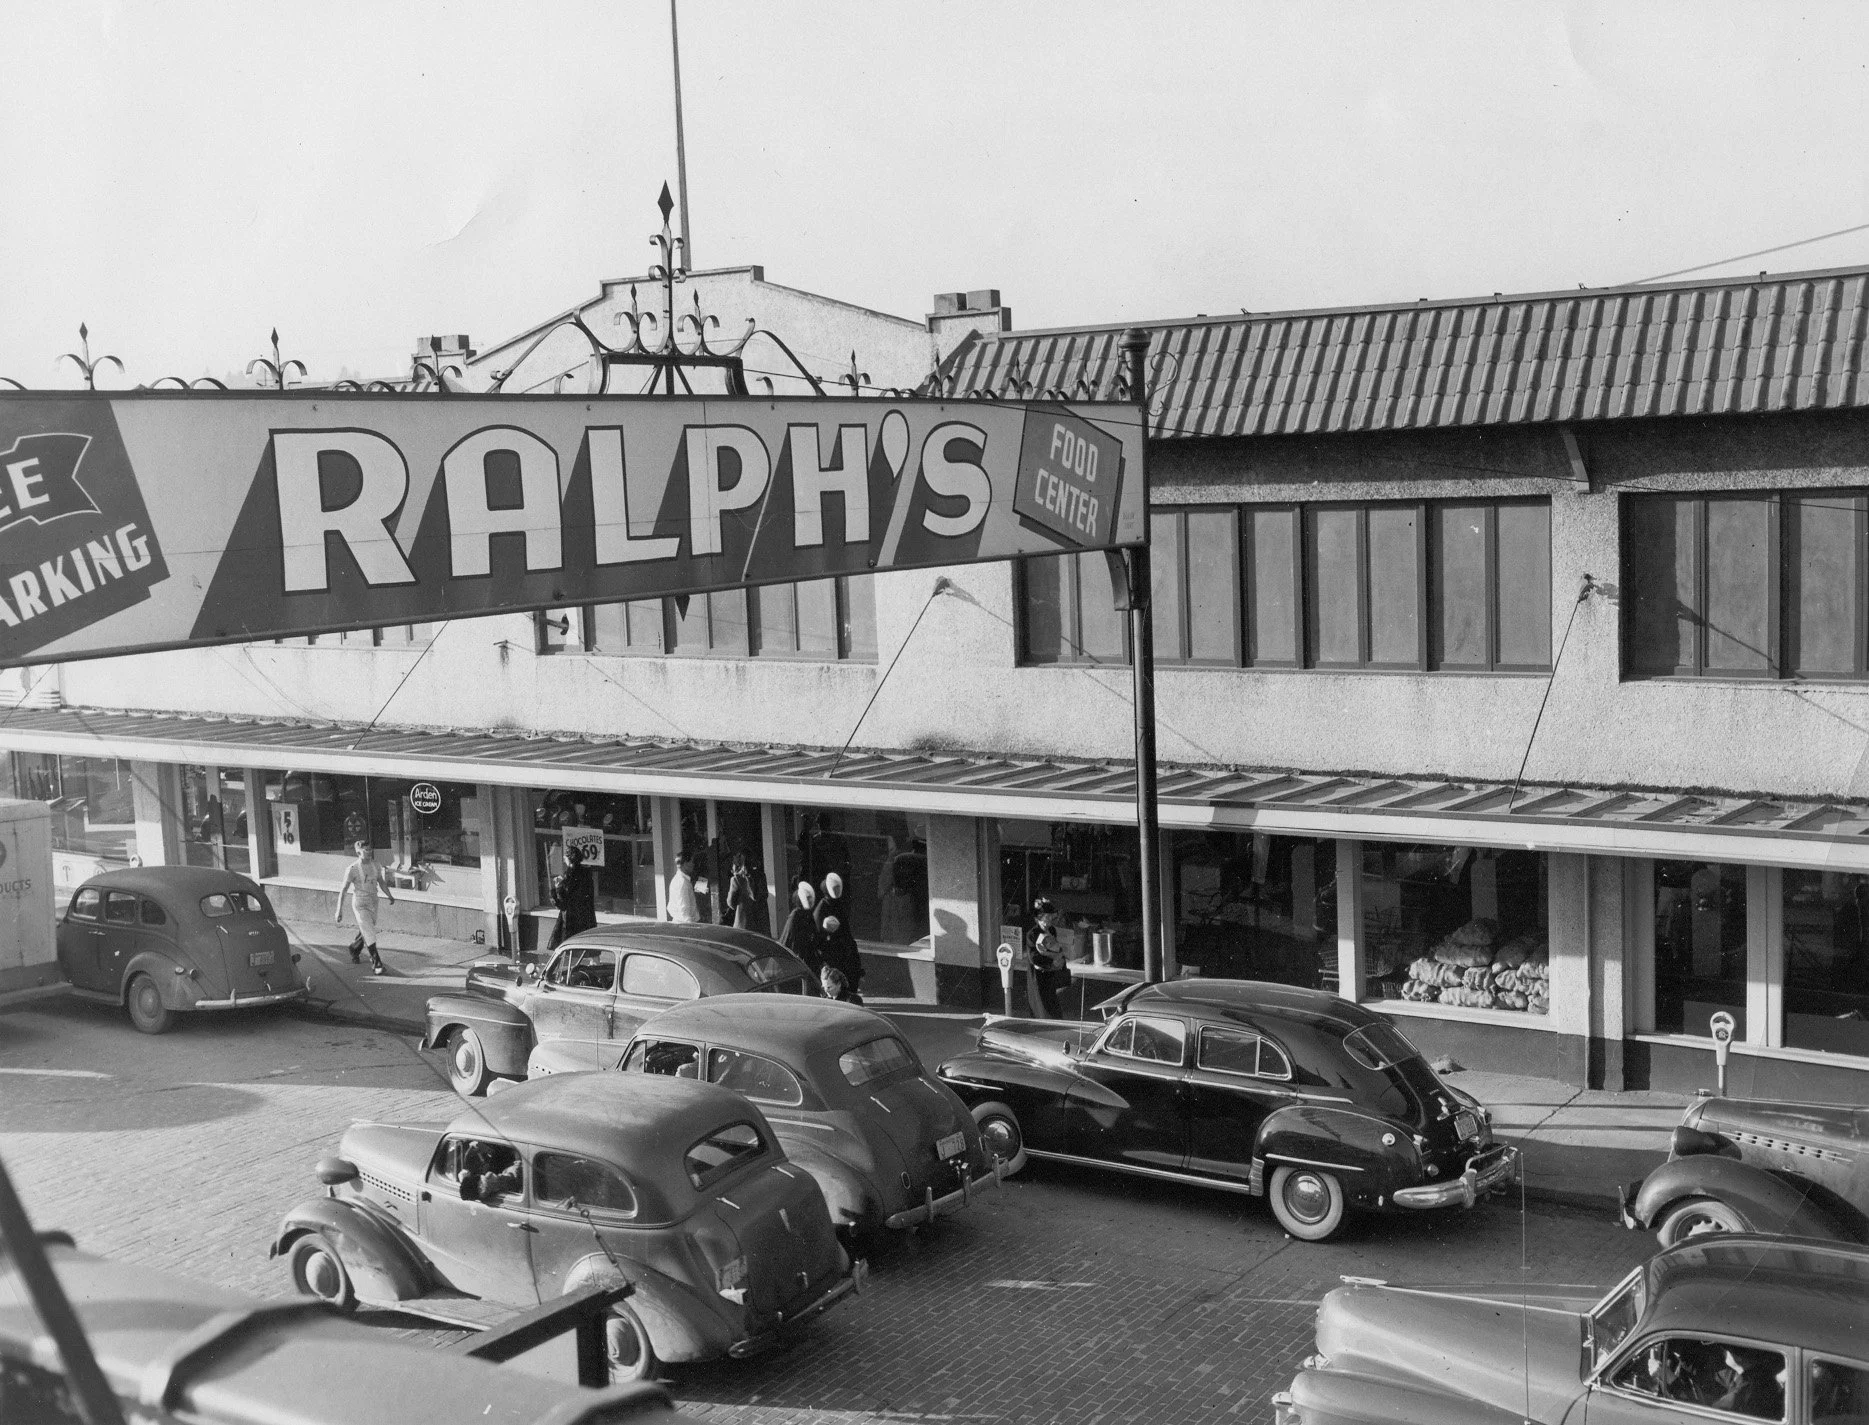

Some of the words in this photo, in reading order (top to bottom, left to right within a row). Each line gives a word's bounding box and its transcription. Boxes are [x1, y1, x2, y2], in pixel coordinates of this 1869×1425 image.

[1050, 423, 1098, 482] FOOD
[269, 409, 992, 593] RALPH'S
[1035, 468, 1098, 537] CENTER
[415, 787, 437, 800] Arden
[284, 811, 292, 828] 5
[283, 832, 295, 845] 10
[566, 834, 603, 848] CHOCOLATES
